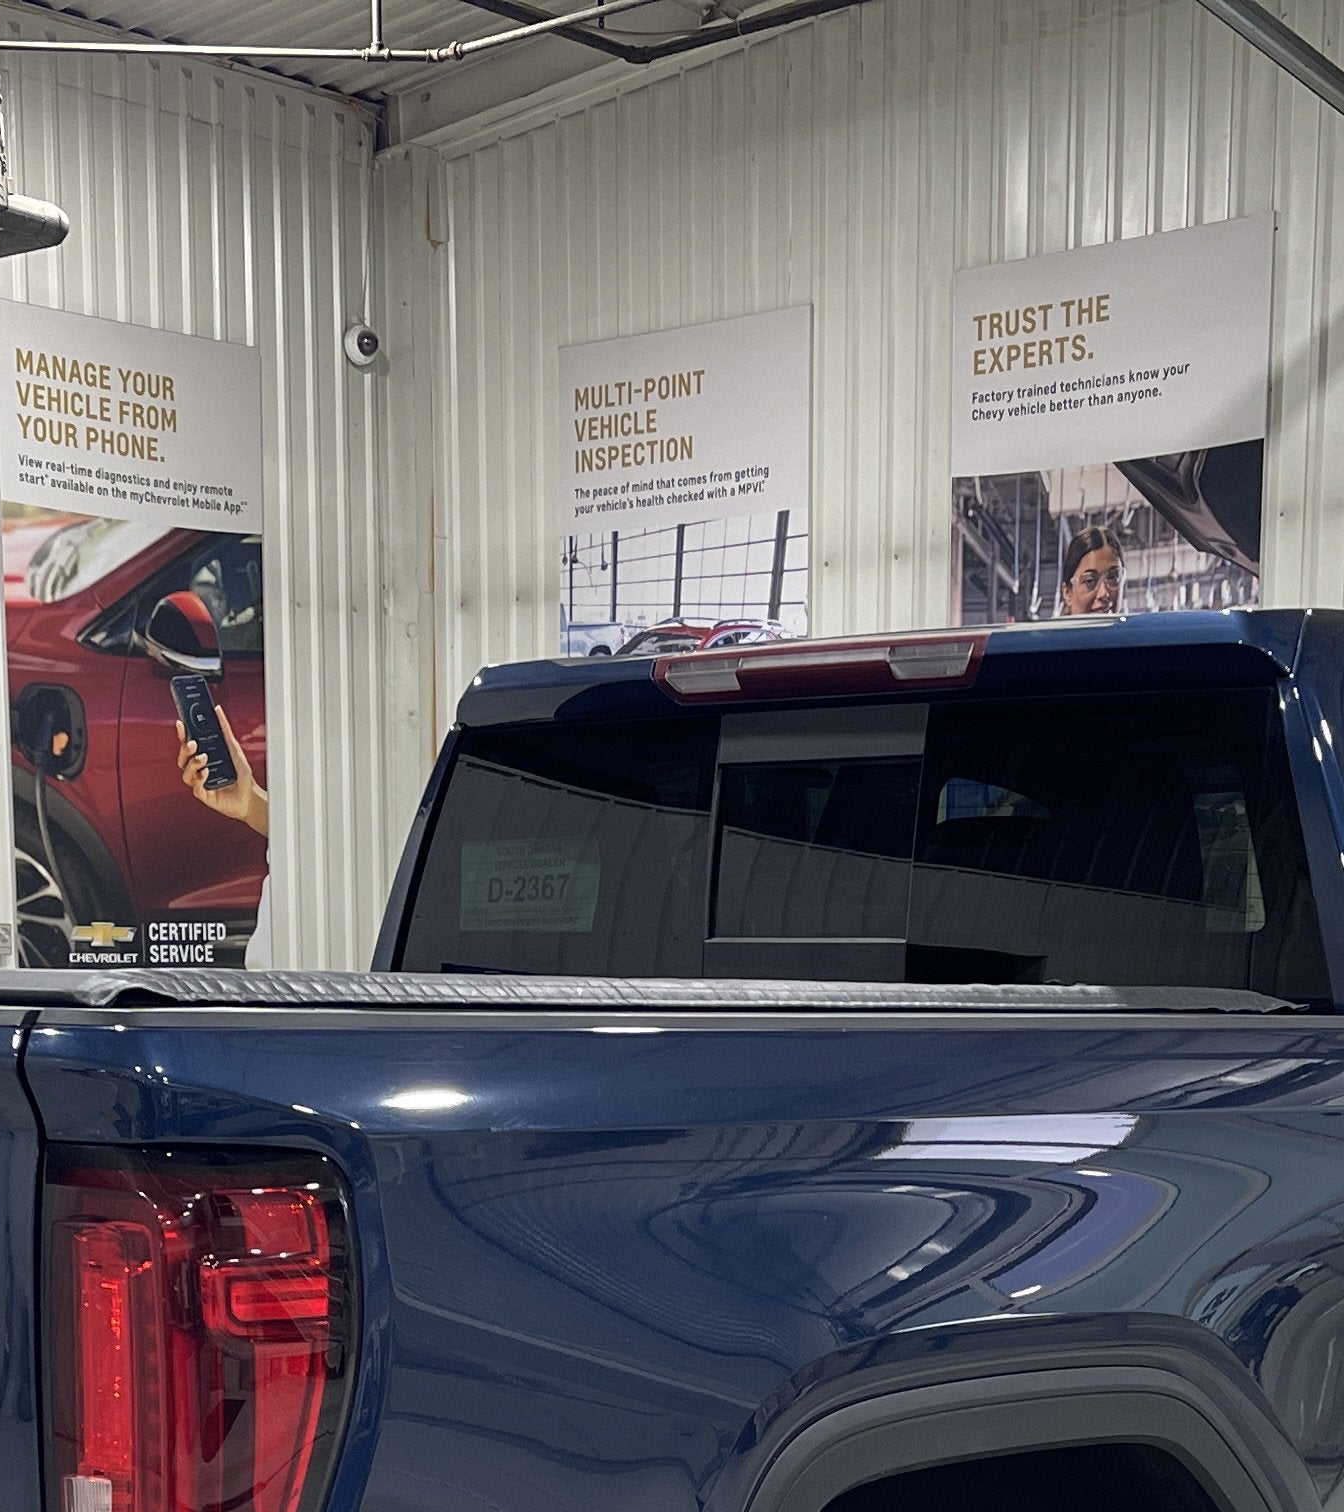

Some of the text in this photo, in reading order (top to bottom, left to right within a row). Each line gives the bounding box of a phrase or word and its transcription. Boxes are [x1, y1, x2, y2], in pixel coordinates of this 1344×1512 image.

[972, 294, 1110, 342] TRUST THE
[15, 347, 175, 401] MANAGE YOUR
[973, 334, 1094, 377] EXPERTS.
[574, 369, 705, 412] MULTI-POINT
[971, 363, 1191, 405] Factory trained technicians know your
[16, 380, 177, 433] VEHICLE FROM
[971, 386, 1163, 423] Chevy vehicle better than anyone.
[16, 413, 166, 463] YOUR PHONE.
[574, 409, 657, 442] VEHICLE
[574, 435, 693, 474] INSPECTION
[18, 453, 233, 498] View real-time diagnostics and enjoy remote
[50, 477, 94, 495] available
[96, 485, 109, 497] on
[111, 486, 128, 500] the
[129, 490, 190, 508] myChevrolet
[192, 498, 221, 512] Mobile
[574, 465, 769, 501] The peace of mind that comes from getting
[574, 503, 594, 518] your
[636, 492, 665, 508] health
[666, 489, 705, 505] checked
[707, 486, 728, 500] with
[730, 486, 736, 497] a
[487, 872, 571, 904] D-2367
[148, 922, 227, 941] CERTIFIED
[69, 952, 138, 964] CHEVROLET
[149, 944, 214, 963] SERVICE
